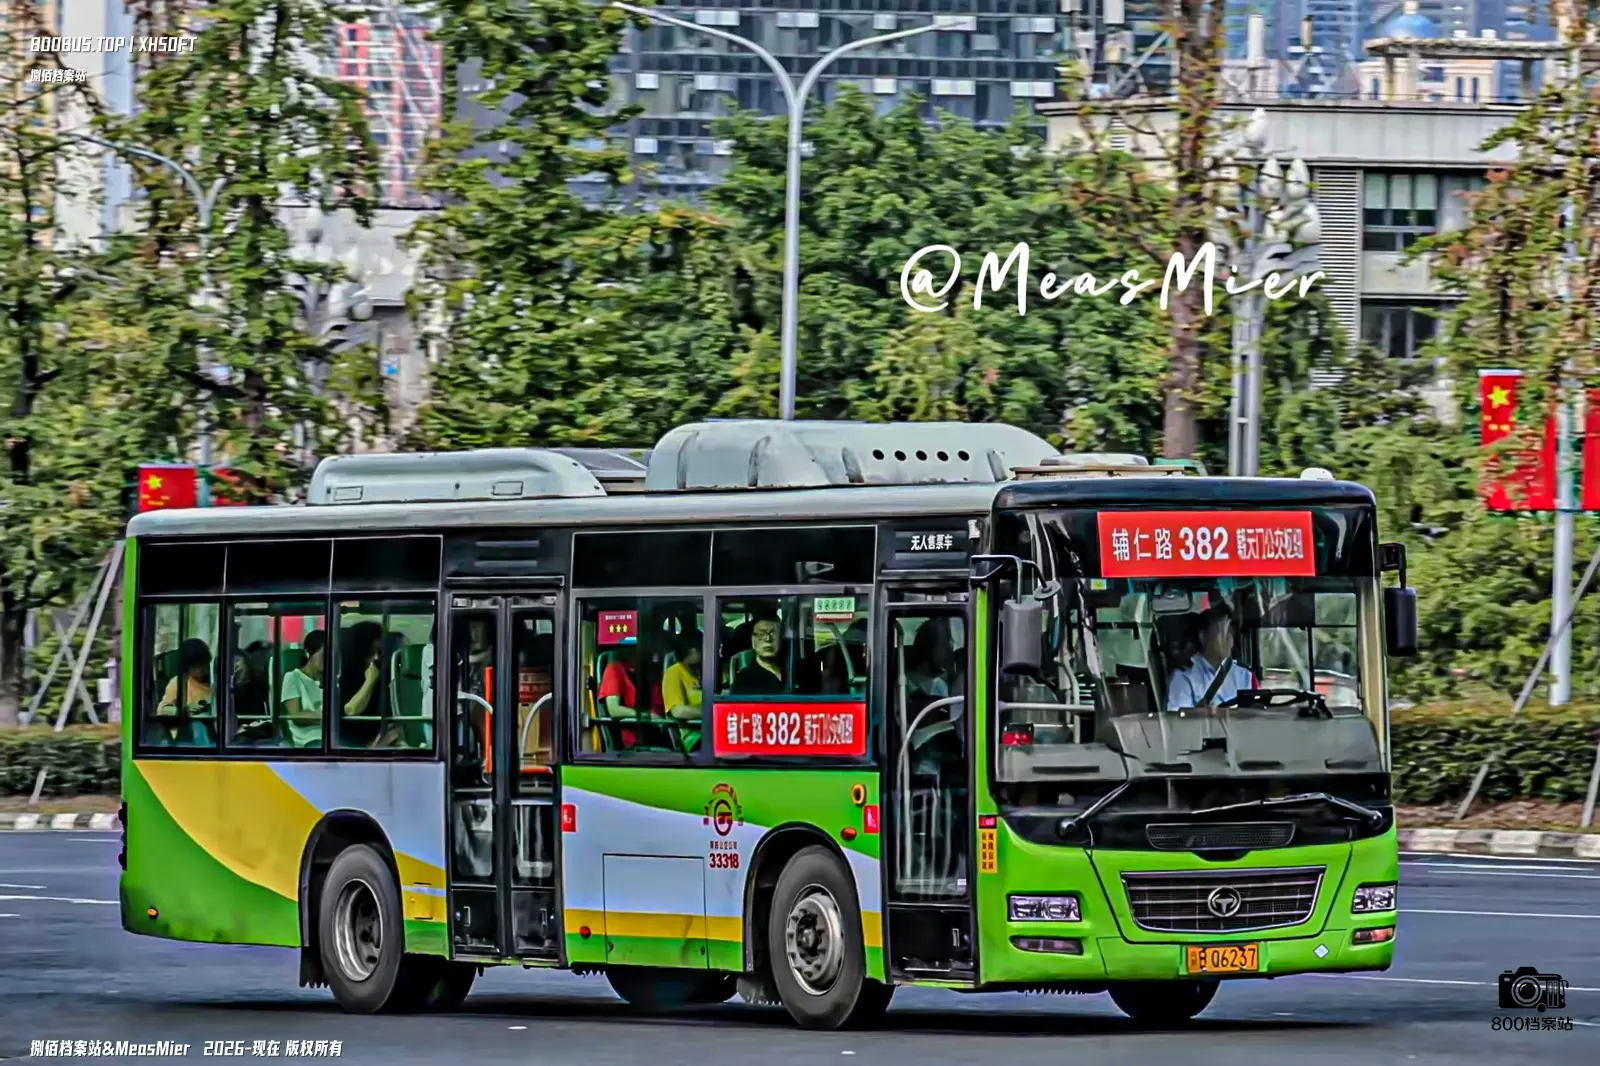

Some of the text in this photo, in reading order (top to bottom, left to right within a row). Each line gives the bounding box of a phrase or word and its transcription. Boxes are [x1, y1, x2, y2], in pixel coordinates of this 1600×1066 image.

[910, 534, 953, 550] 无人售票车
[1112, 528, 1172, 561] 辅仁路
[1179, 527, 1229, 560] 382
[766, 712, 800, 745] 382
[709, 853, 739, 869] 33318
[1211, 948, 1256, 968] 06237
